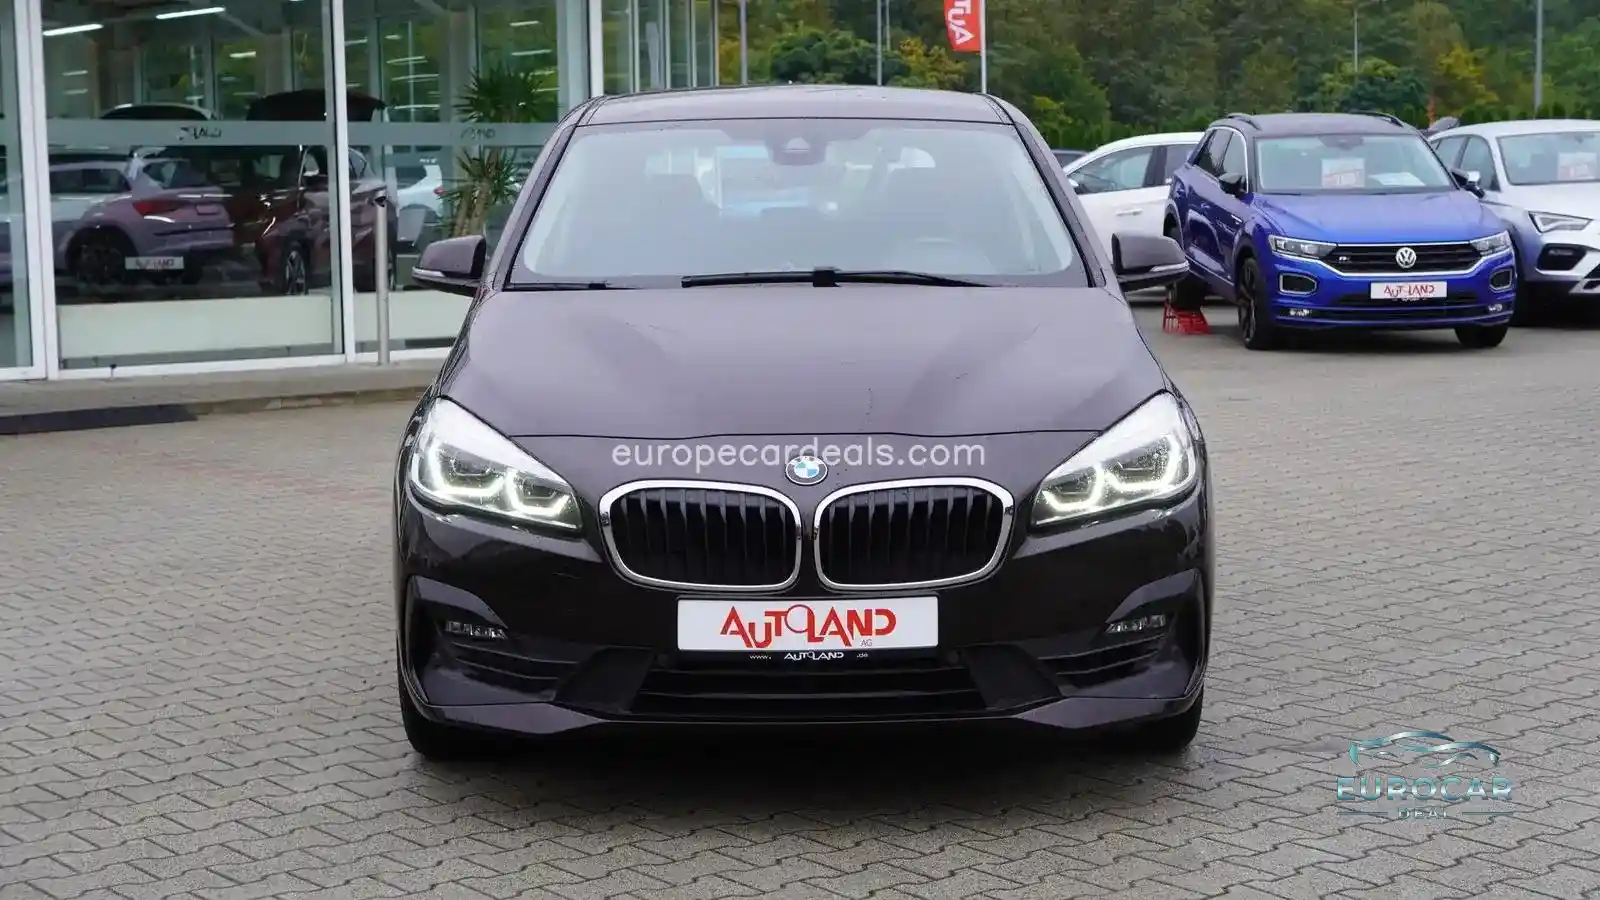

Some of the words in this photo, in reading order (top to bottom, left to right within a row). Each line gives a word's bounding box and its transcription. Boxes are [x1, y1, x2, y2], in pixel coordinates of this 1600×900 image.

[1384, 285, 1435, 297] AUTLAND
[720, 604, 896, 649] AUTOLAND
[860, 639, 873, 647] AG
[784, 650, 844, 660] AUTOLAND
